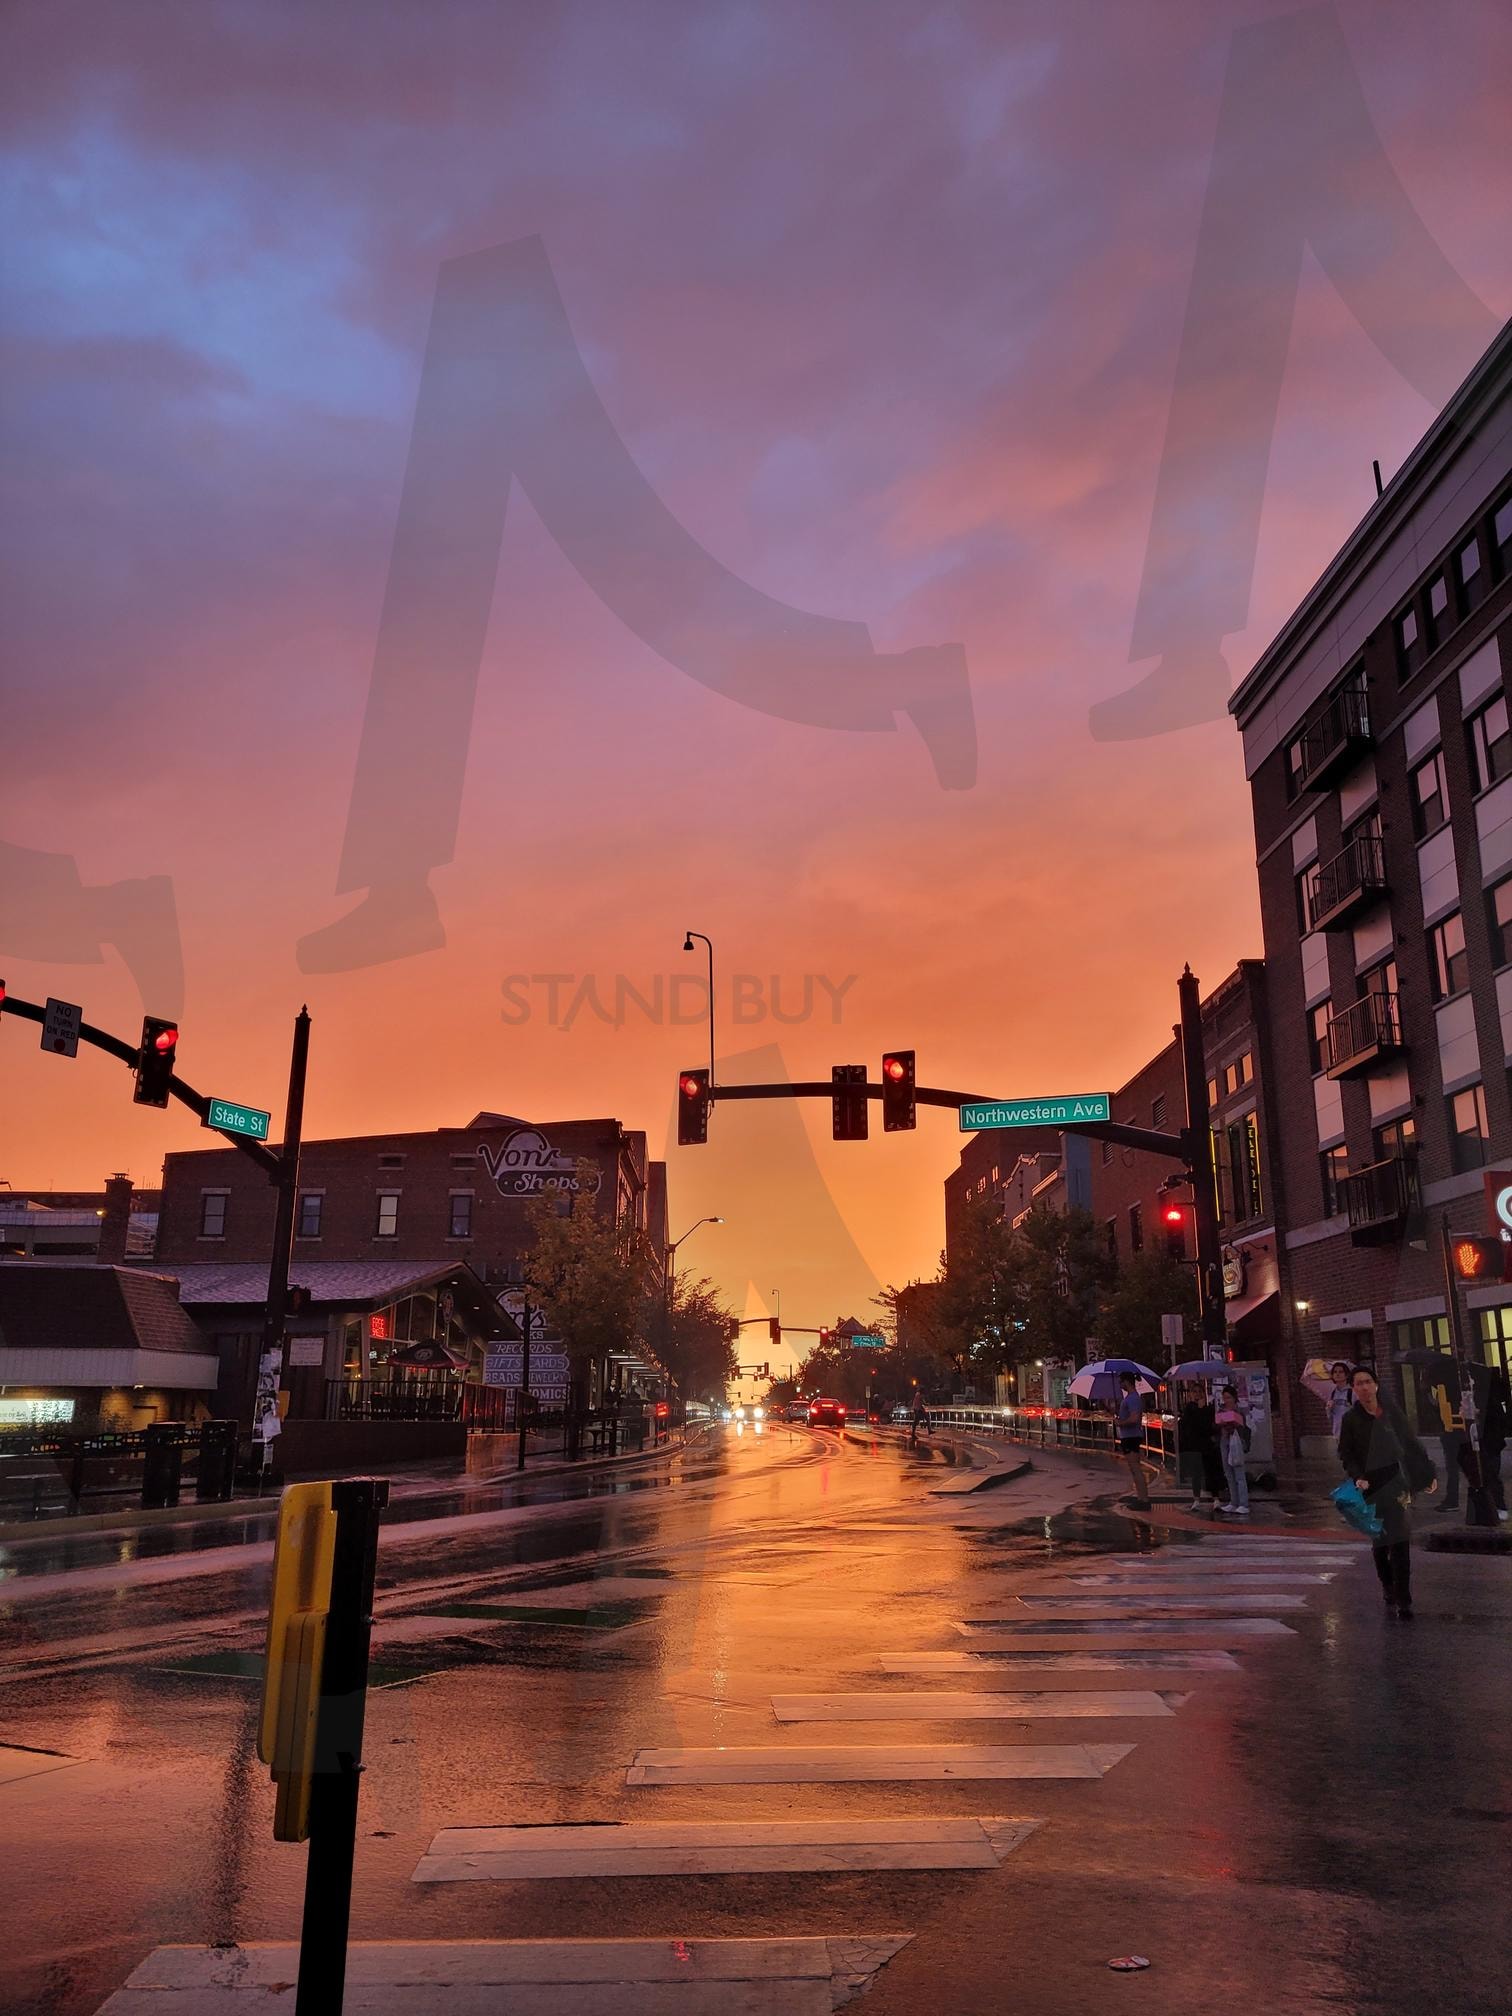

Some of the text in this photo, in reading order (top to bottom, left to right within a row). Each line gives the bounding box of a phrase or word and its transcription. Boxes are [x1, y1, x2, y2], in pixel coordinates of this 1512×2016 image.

[56, 1005, 72, 1017] NO
[47, 1025, 76, 1040] ON RED
[214, 1107, 263, 1133] State St
[964, 1102, 1104, 1124] Northwestern Ave
[514, 1173, 580, 1193] Shops
[529, 1371, 567, 1383] EWELRY
